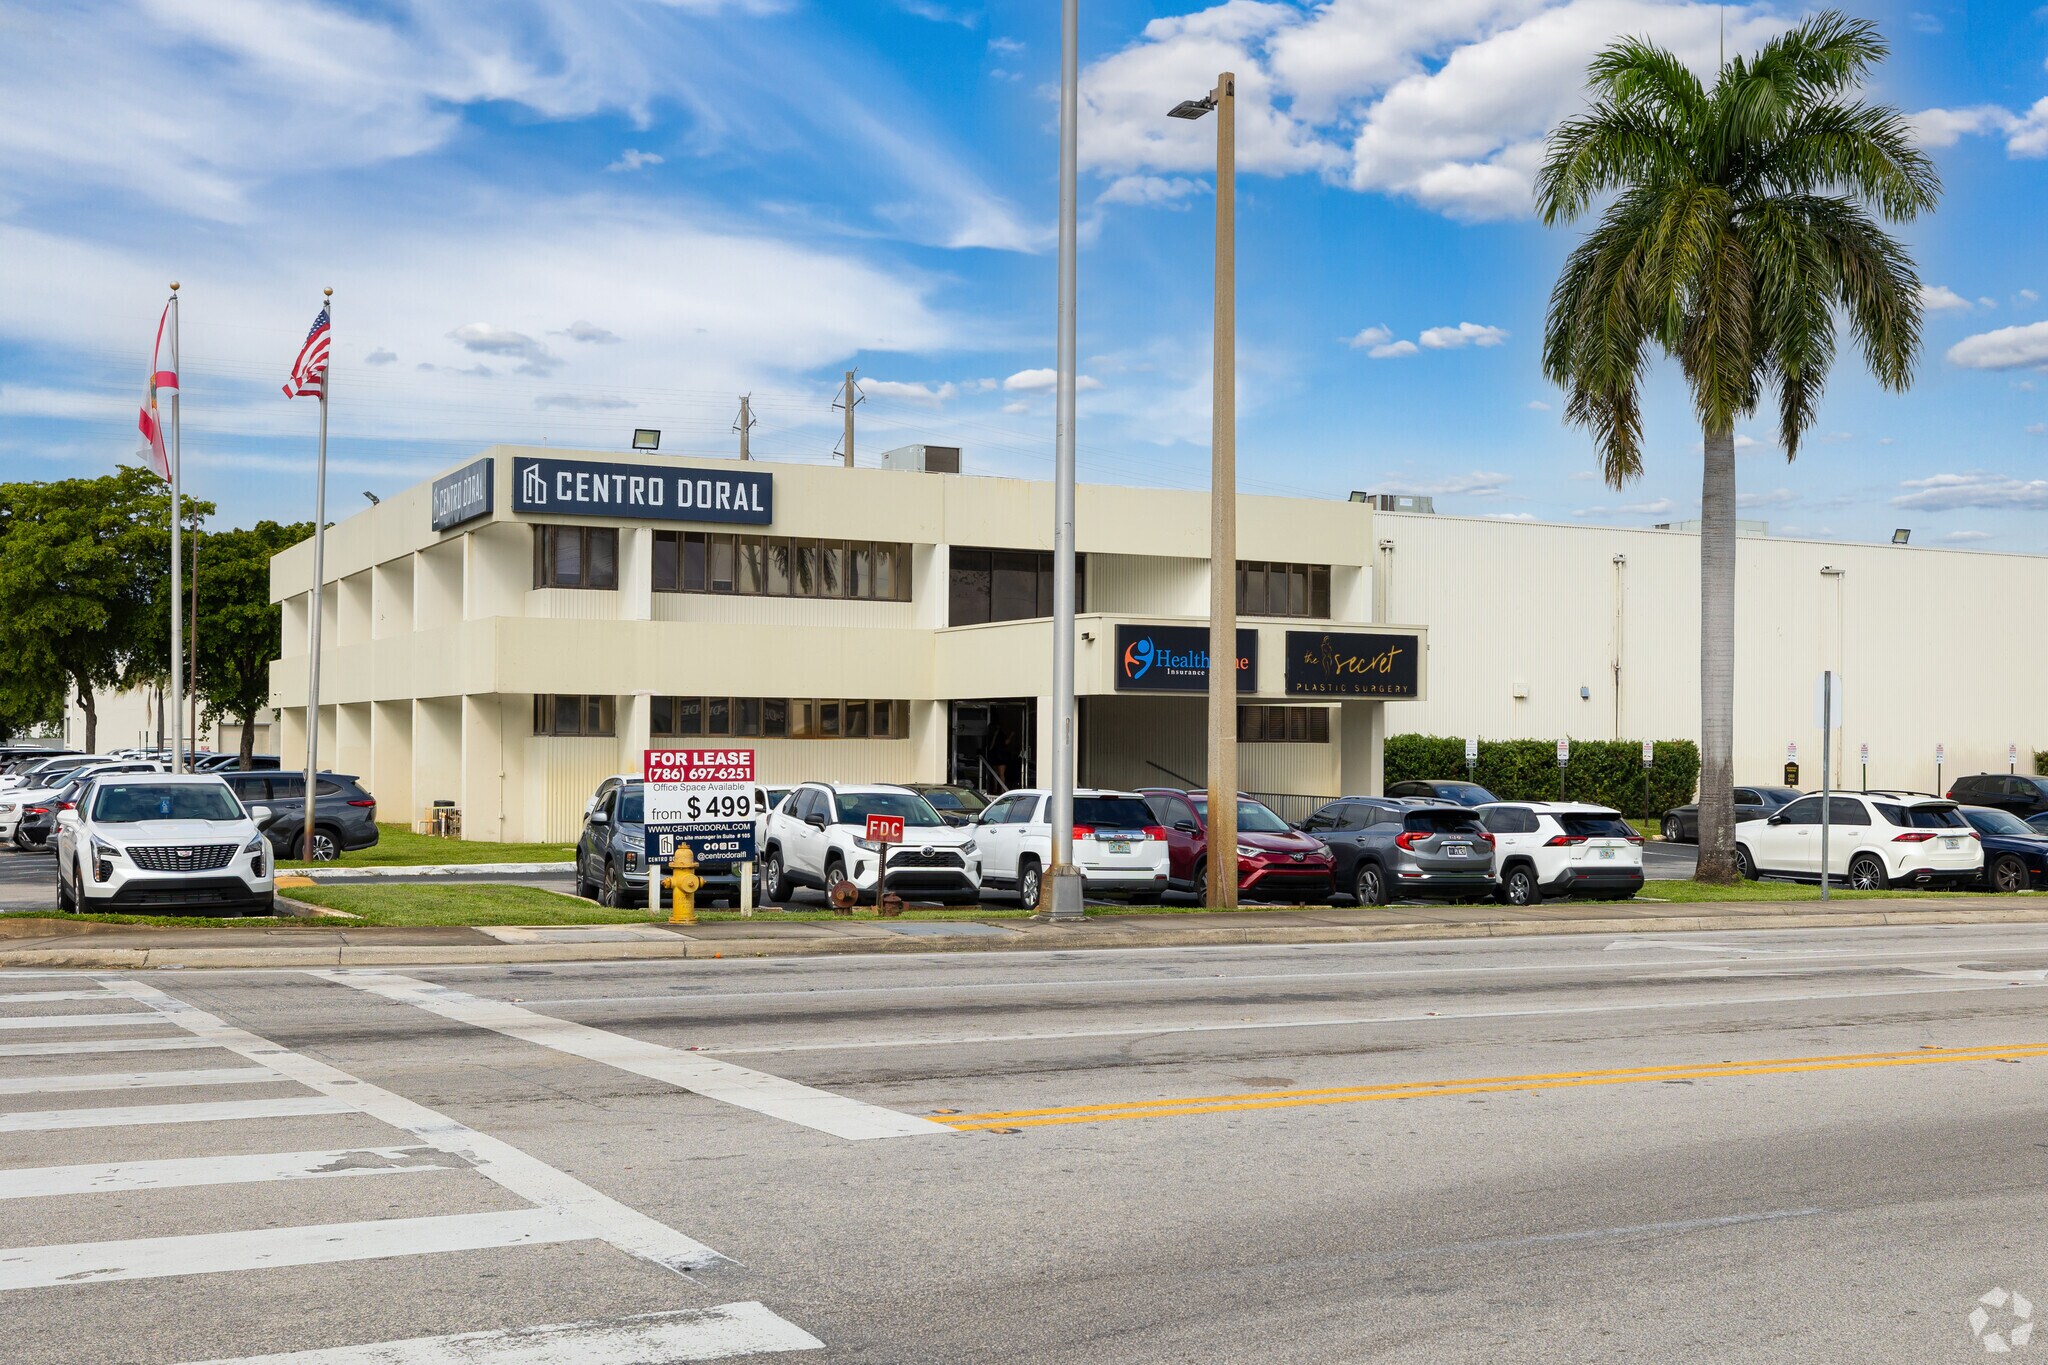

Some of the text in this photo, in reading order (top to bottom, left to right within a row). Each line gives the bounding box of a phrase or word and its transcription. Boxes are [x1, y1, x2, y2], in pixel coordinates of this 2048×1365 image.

[556, 471, 764, 512] CENTRO DORAL
[1303, 644, 1403, 675] the secret
[1167, 668, 1205, 676] Insurance
[1296, 683, 1409, 693] PLASTIC SURGERY
[650, 752, 750, 766] FOR LEASE
[648, 767, 750, 782] (786) 697-6251
[653, 782, 745, 793] Office Space Available
[651, 808, 682, 820] from
[647, 823, 751, 834] WWW.CENTRODORAL.COM
[869, 820, 900, 837] FDC
